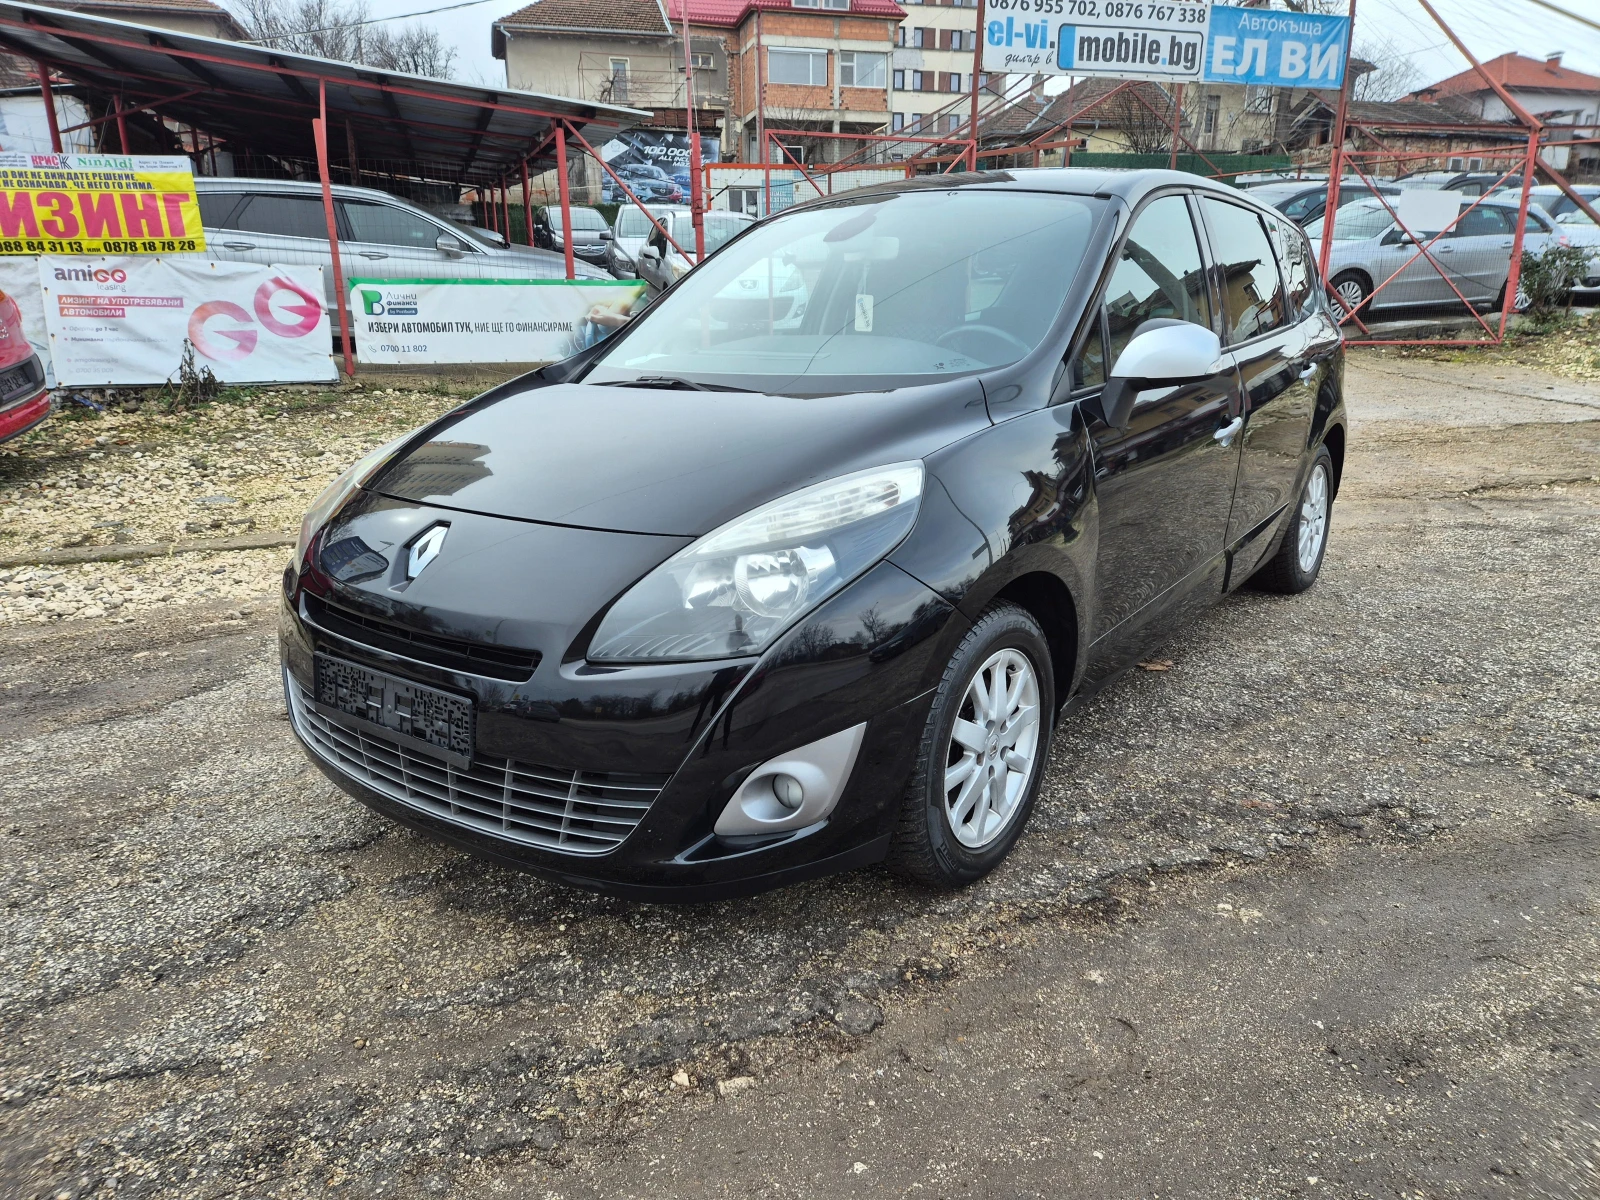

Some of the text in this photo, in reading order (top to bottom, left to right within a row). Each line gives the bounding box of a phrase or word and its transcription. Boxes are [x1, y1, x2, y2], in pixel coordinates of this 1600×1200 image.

[989, 0, 1206, 24] 0876 955 702, 0876 767 338
[1238, 12, 1322, 38] Автокъща
[1078, 32, 1198, 71] mobile.bg
[1211, 35, 1340, 80] ЕЛ ВИ
[643, 146, 665, 155] 100
[31, 155, 60, 166] КРИС
[0, 170, 9, 178] О
[11, 170, 29, 179] ВИЕ
[30, 171, 43, 180] НЕ
[44, 172, 91, 181] ВИЖДАТЕ
[2, 179, 15, 188] НЕ
[17, 179, 67, 188] ОЗНАЧАВА
[87, 181, 110, 189] НЕГО
[112, 181, 123, 190] ГО
[26, 241, 46, 252] 84
[48, 241, 65, 252] 31
[67, 241, 83, 252] 13
[103, 241, 138, 253] 0878
[141, 241, 157, 252] 18
[159, 240, 175, 251] 78
[178, 240, 196, 250] 28
[97, 283, 127, 292] leasing
[386, 292, 417, 300] Лични
[111, 298, 181, 306] УПОТРЕБЯВАНИ
[62, 308, 123, 316] АВТОМОБИЛИ
[368, 321, 574, 335] ИЗБЕРИ АВТОМОБИЛ ТУК, НИЕ ЩЕ ГО ФИНАНСИРАМЕ
[381, 344, 428, 353] 0700 11 802
